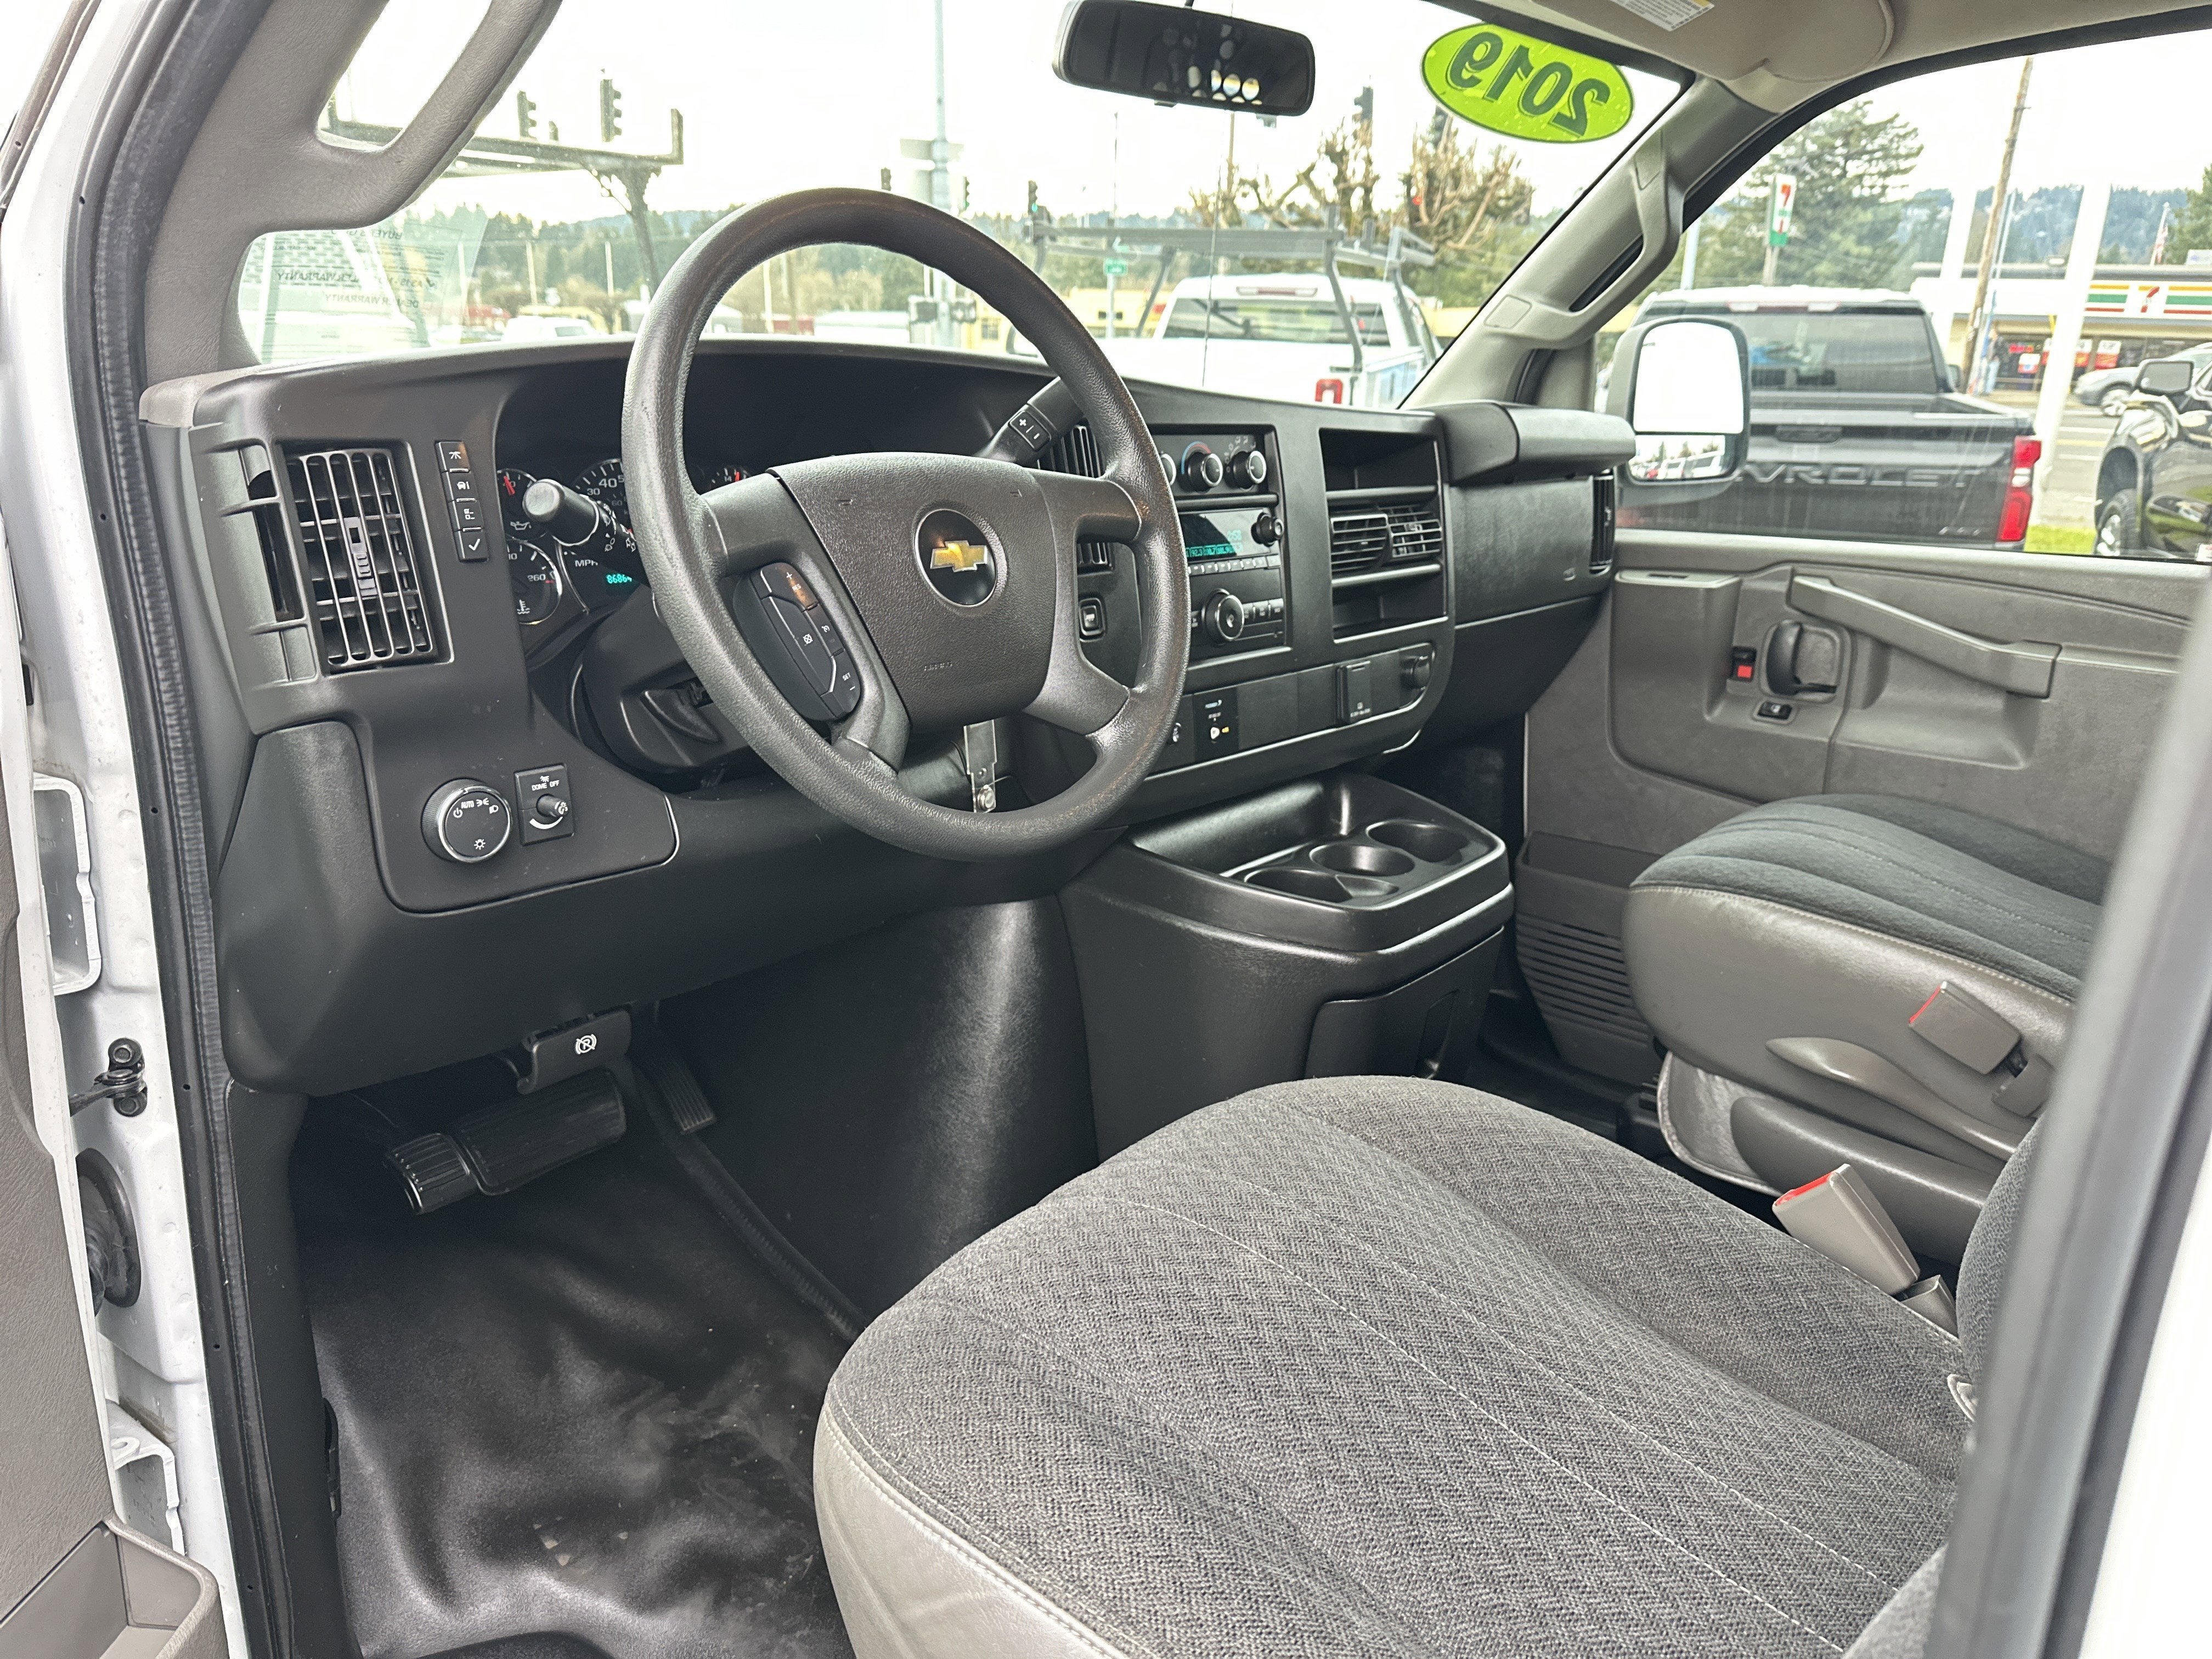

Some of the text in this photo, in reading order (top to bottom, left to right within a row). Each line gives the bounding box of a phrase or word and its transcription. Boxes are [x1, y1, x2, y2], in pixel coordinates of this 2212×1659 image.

[1734, 464, 1986, 488] VROLET
[599, 478, 618, 488] 40
[586, 488, 601, 496] 30
[527, 573, 546, 582] 260
[842, 672, 851, 681] SET
[531, 782, 548, 791] DOME
[461, 800, 475, 809] AUTO
